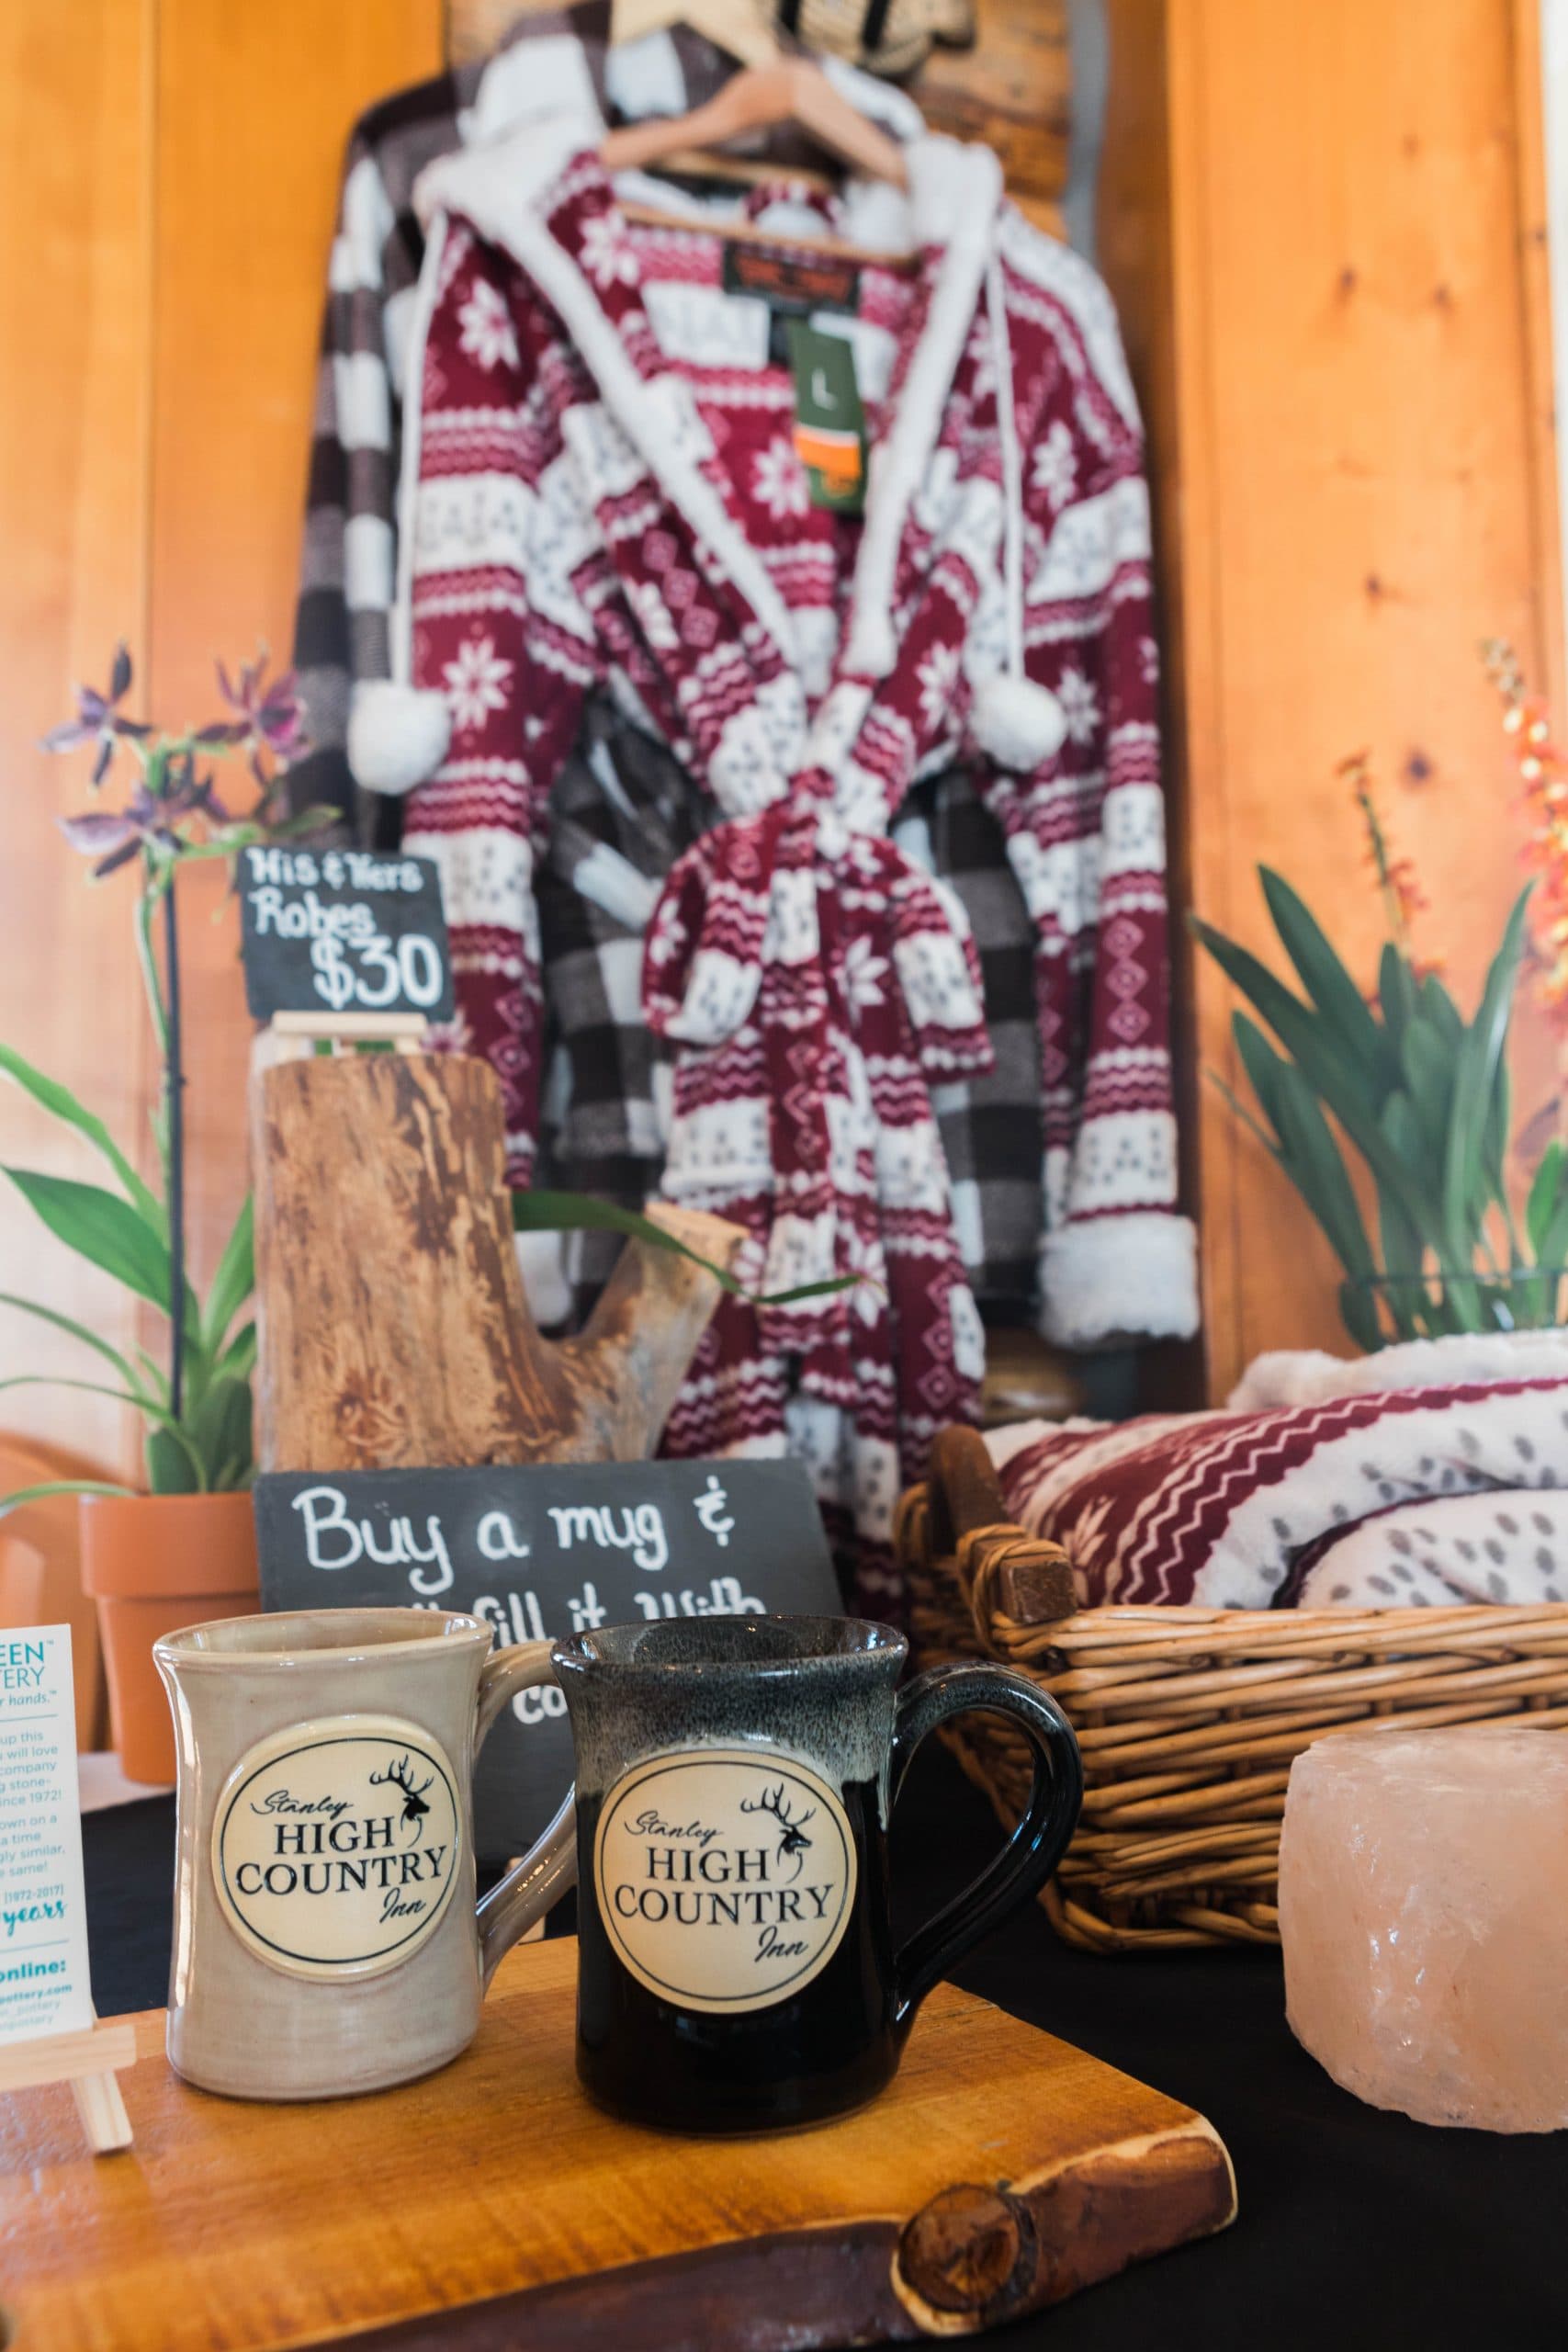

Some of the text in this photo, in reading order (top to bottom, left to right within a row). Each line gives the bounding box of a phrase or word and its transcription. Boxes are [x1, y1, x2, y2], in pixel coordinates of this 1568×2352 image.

[811, 367, 838, 411] L
[247, 886, 377, 941] Robes
[310, 933, 444, 1011] $30
[291, 1476, 735, 1596] Buy a mug &
[567, 1581, 607, 1632] it
[0, 1666, 45, 1690] ERY
[7, 1747, 28, 1759] will
[31, 1745, 59, 1758] love
[20, 1731, 44, 1743] this
[250, 1790, 354, 1821] Stanley
[273, 1815, 395, 1855] HIGH
[624, 1810, 725, 1849] Stanley
[235, 1845, 447, 1896] COUNTRY
[645, 1847, 771, 1883] HIGH
[3, 1899, 67, 1938] years
[378, 1887, 427, 1924] Inn
[614, 1883, 835, 1926] COUNTRY
[753, 1926, 809, 1963] Inn
